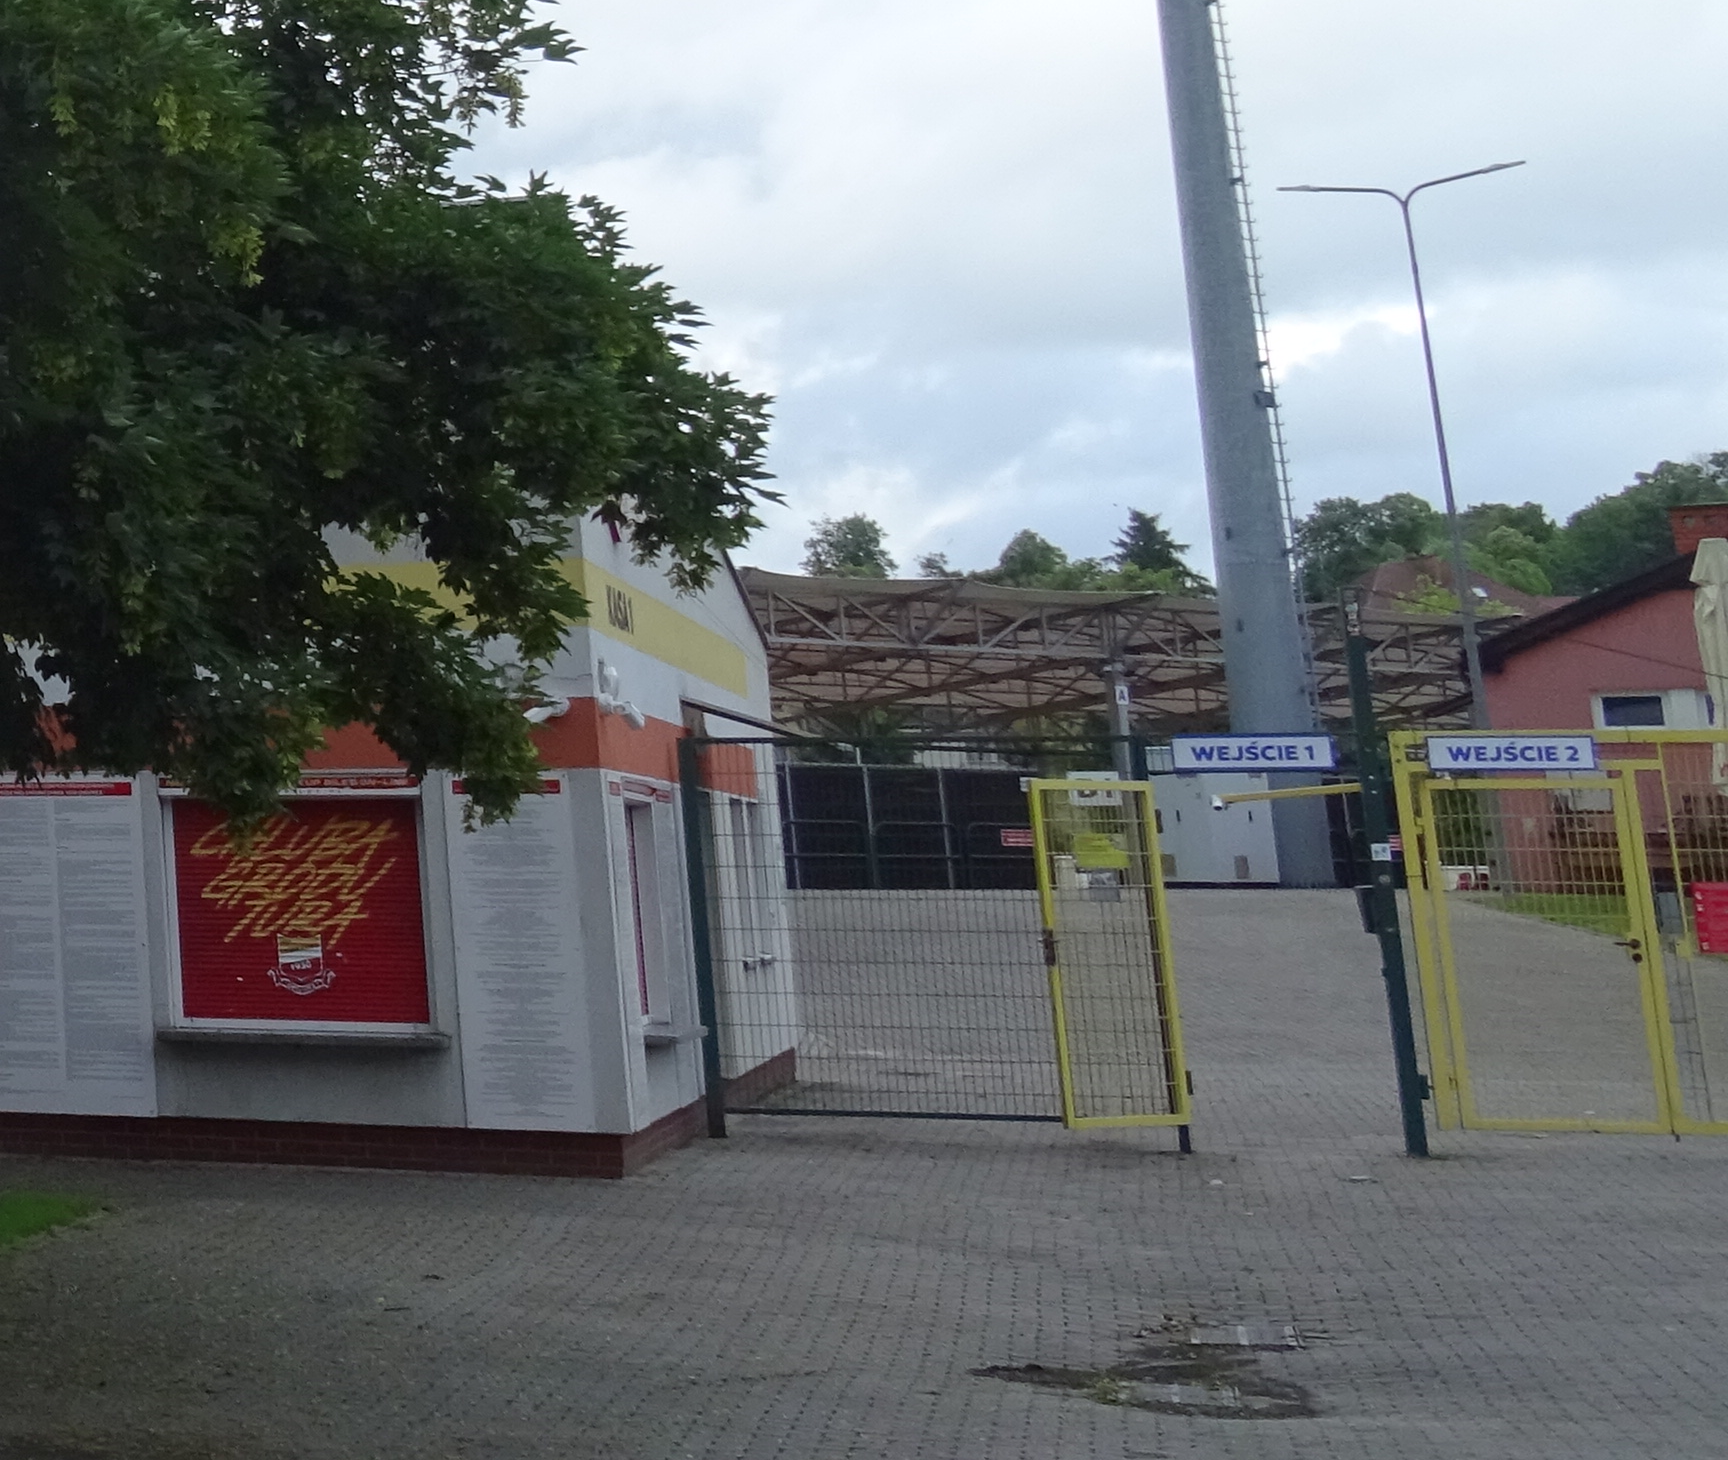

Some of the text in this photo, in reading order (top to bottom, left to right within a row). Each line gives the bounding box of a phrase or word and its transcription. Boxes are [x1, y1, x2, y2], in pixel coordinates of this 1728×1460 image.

[606, 585, 630, 633] KASA
[1190, 741, 1315, 762] WEJŚCIE 1
[1446, 741, 1580, 762] WEJŚCIE 2
